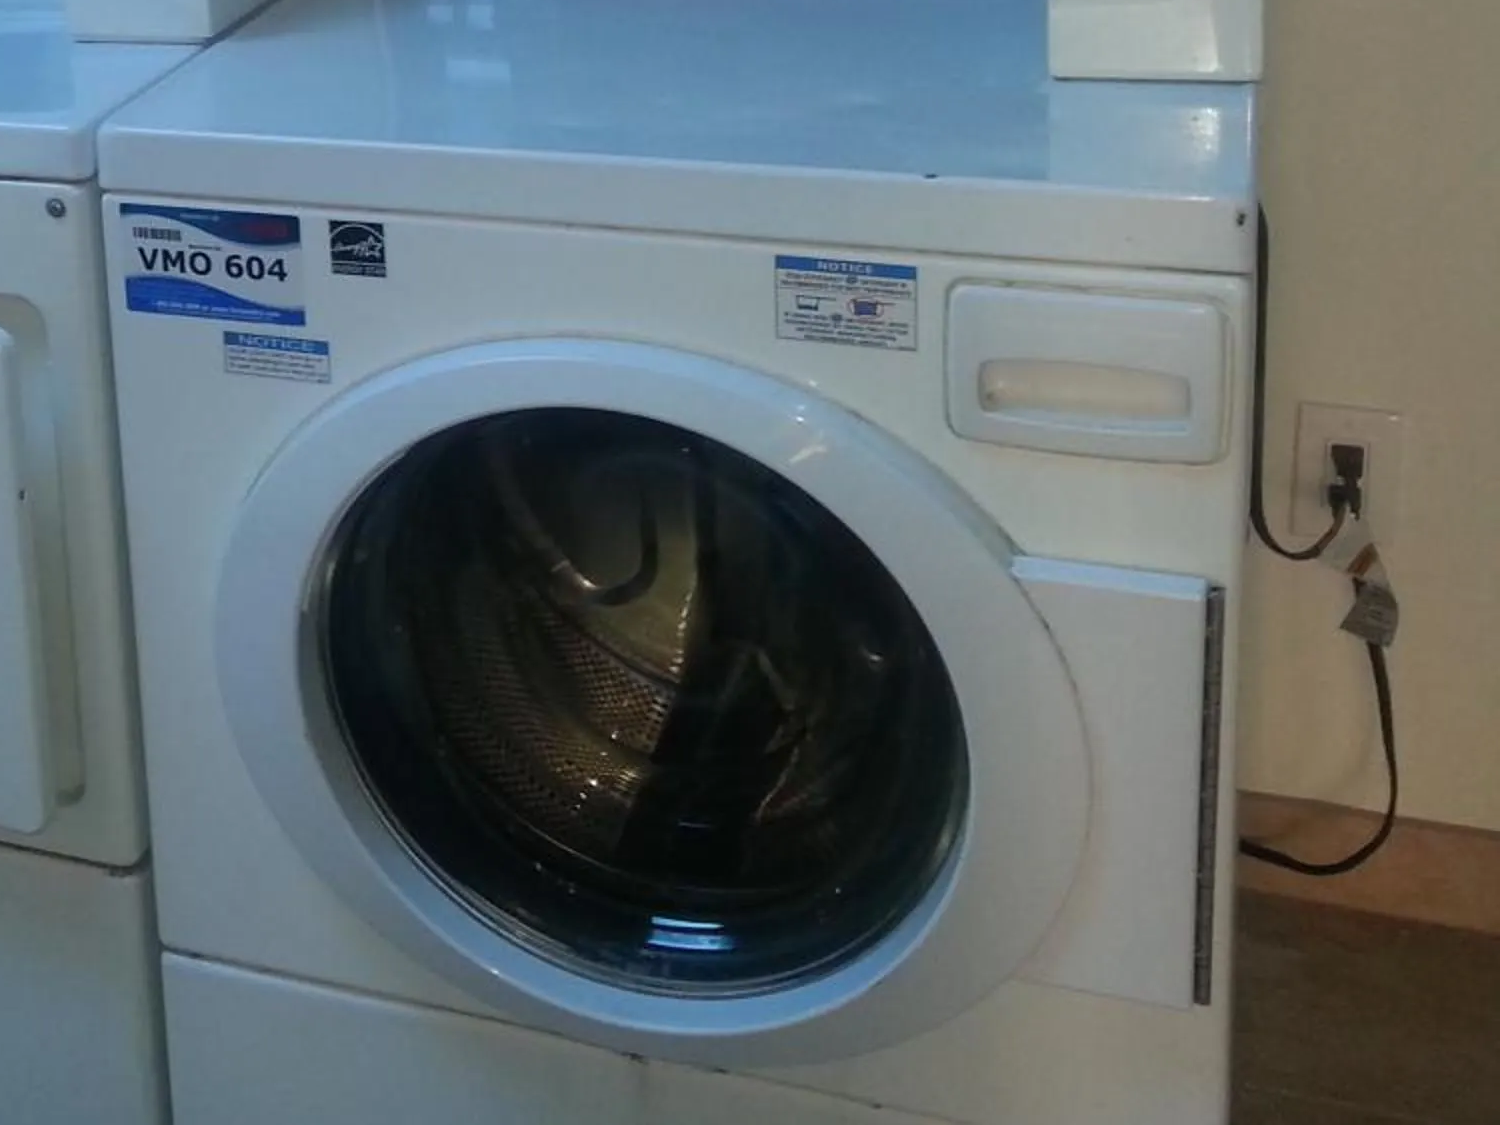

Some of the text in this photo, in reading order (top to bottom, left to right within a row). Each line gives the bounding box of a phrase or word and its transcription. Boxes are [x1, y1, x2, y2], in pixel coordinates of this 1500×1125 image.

[137, 246, 289, 283] VMO 604
[816, 260, 874, 275] NOTICE
[238, 333, 318, 354] NOTICE
